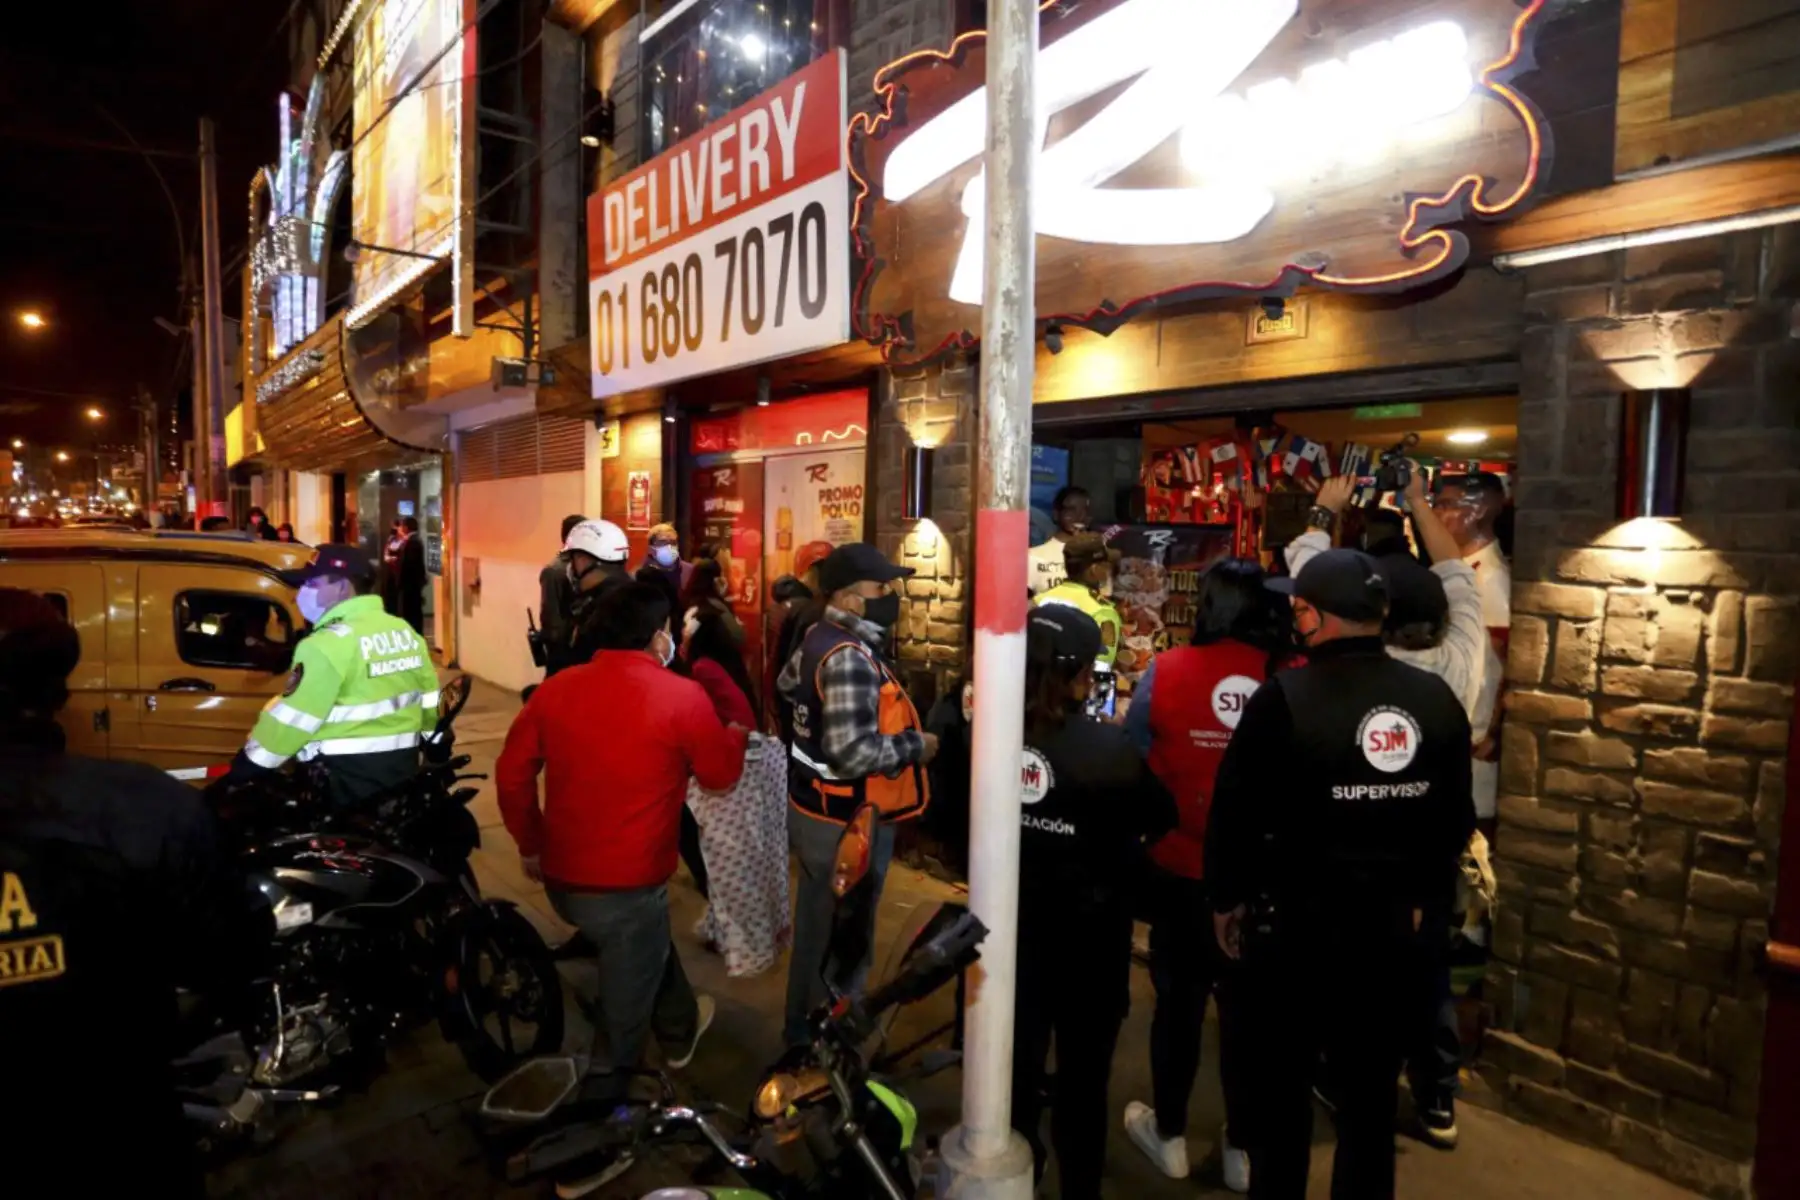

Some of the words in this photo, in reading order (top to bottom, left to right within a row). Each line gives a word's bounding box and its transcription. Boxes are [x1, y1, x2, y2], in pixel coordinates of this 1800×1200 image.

[603, 81, 807, 265] DELIVERY
[597, 281, 630, 376] 01
[640, 252, 704, 364] 680
[714, 201, 828, 343] 7070
[818, 484, 863, 503] PROMO
[1368, 729, 1408, 753] SJM
[1021, 812, 1076, 836] ZACIÓN
